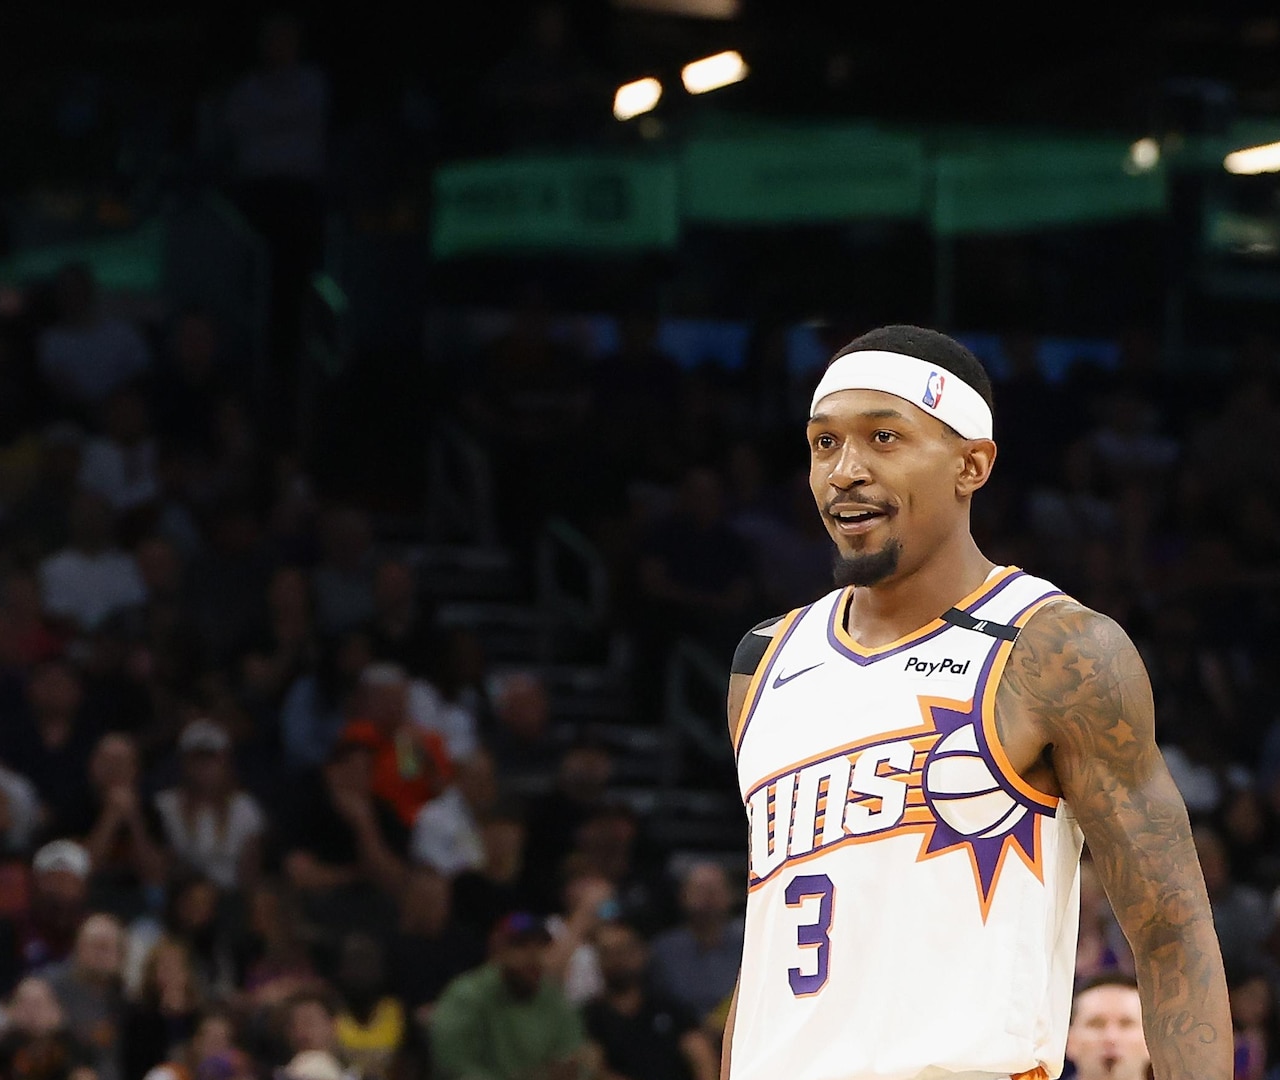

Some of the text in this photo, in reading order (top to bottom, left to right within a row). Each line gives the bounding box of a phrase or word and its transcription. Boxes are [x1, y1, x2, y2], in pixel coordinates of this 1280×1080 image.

[904, 657, 971, 677] PayPal
[747, 741, 915, 880] UNS
[784, 873, 837, 999] 3
